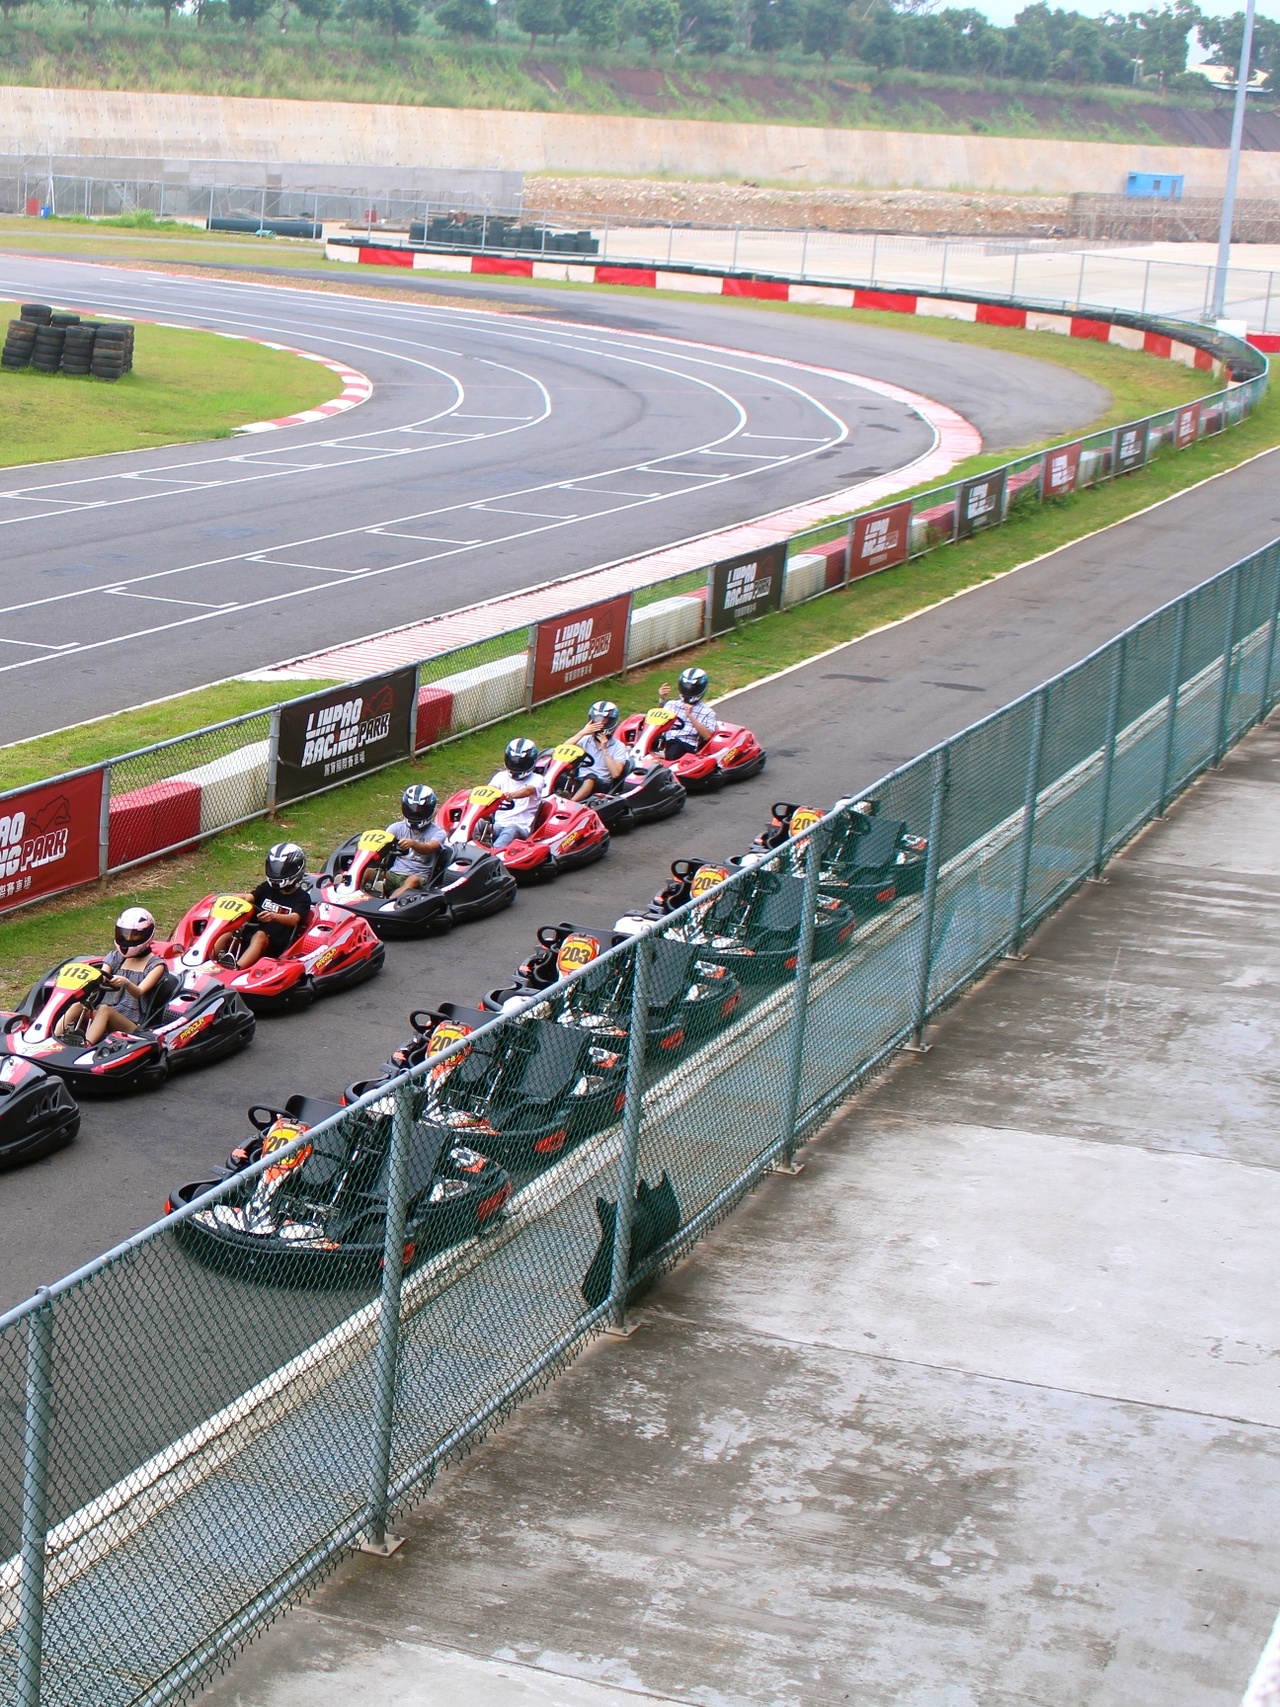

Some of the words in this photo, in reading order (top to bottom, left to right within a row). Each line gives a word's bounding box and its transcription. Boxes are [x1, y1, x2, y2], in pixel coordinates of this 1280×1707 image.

[305, 697, 363, 740] LIHPAO
[301, 723, 359, 768] RACING
[558, 748, 576, 757] 111
[473, 788, 495, 798] 107
[792, 817, 818, 831] 20
[363, 833, 386, 844] 112
[20, 828, 68, 872] PARK
[219, 899, 244, 912] 101
[561, 946, 590, 964] 203
[63, 966, 92, 980] 115
[431, 1035, 460, 1052] 20
[266, 1136, 289, 1154] 20
